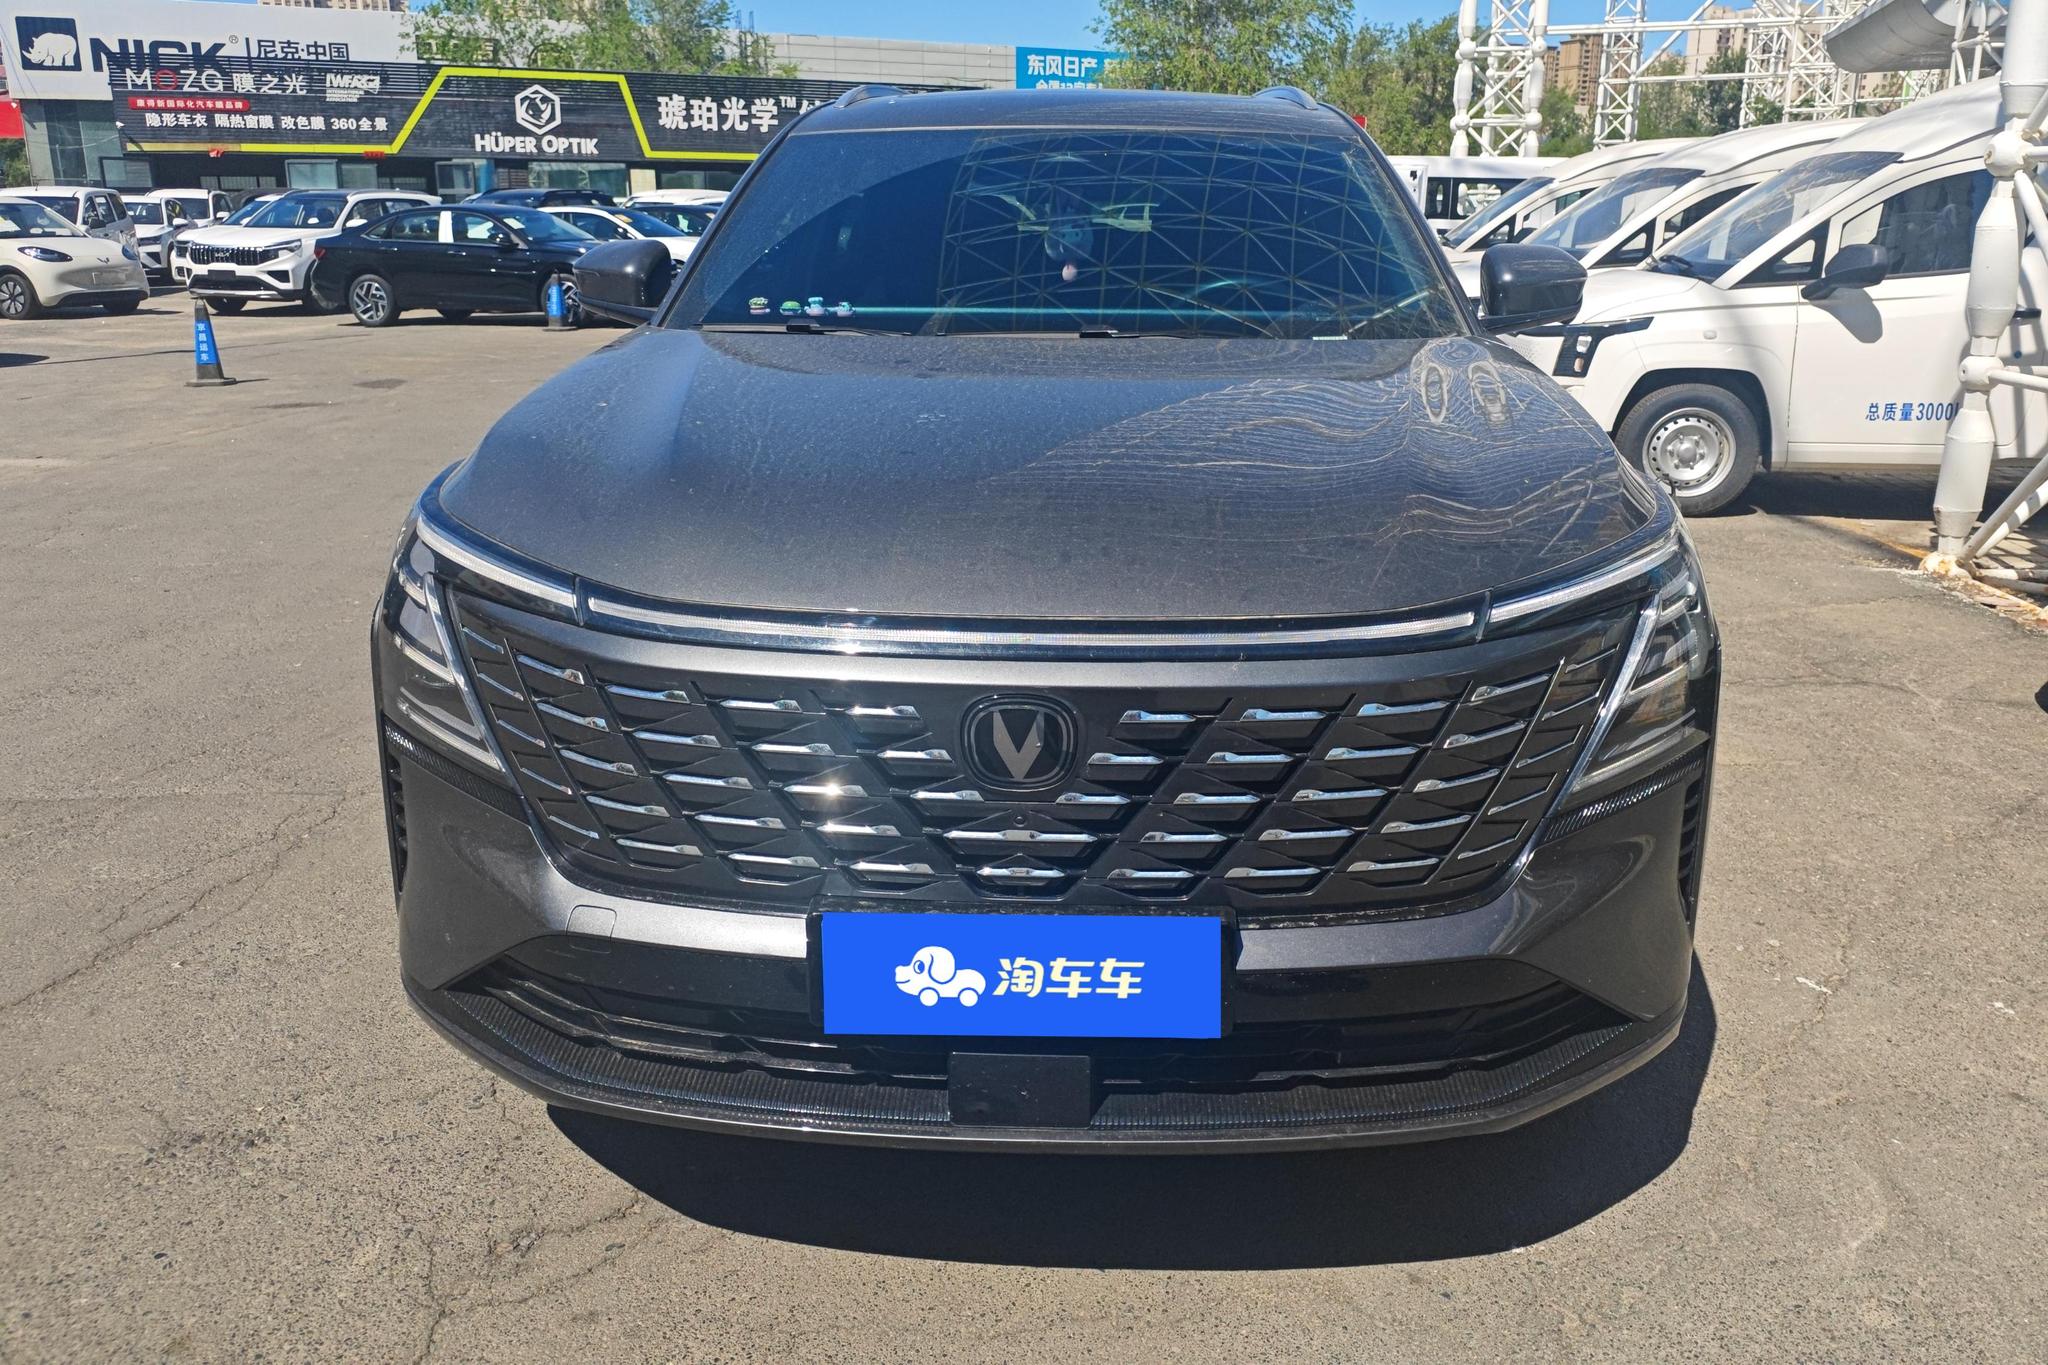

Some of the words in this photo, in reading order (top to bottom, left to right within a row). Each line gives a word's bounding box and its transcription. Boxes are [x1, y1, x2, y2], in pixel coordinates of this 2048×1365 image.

[125, 68, 224, 92] MOZG
[232, 73, 308, 95] 膜之光
[145, 112, 209, 128] 隐形车衣
[214, 113, 275, 129] 隔热窗膜
[281, 115, 326, 130] 改色膜
[474, 131, 538, 153] HÜPER
[541, 135, 599, 155] OPTIK
